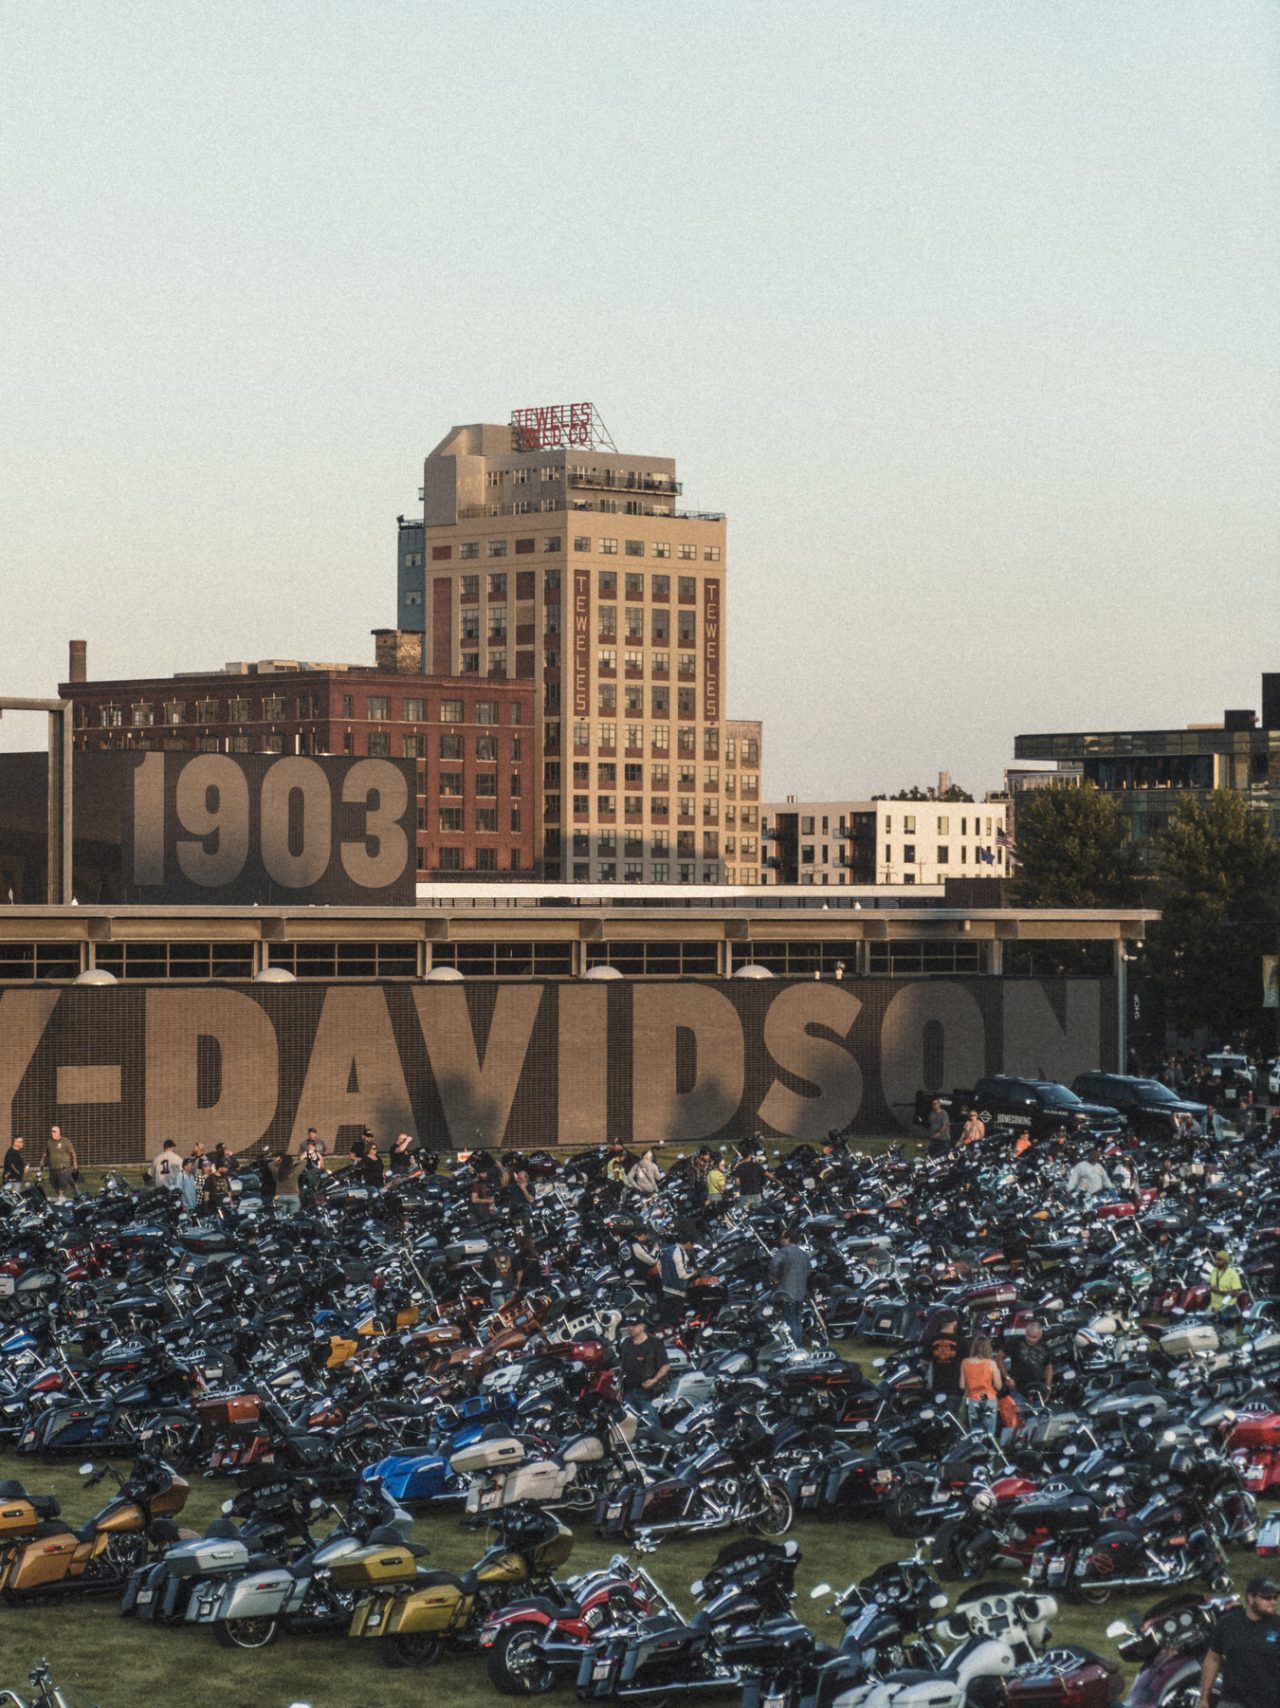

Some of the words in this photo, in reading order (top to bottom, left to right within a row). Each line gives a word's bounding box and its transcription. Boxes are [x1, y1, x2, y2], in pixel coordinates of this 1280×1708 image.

[515, 402, 590, 432] TEWELES
[575, 576, 588, 711] TEWELES
[706, 585, 717, 716] TEWELES
[133, 751, 409, 889] 1903
[161, 1160, 170, 1174] 1
